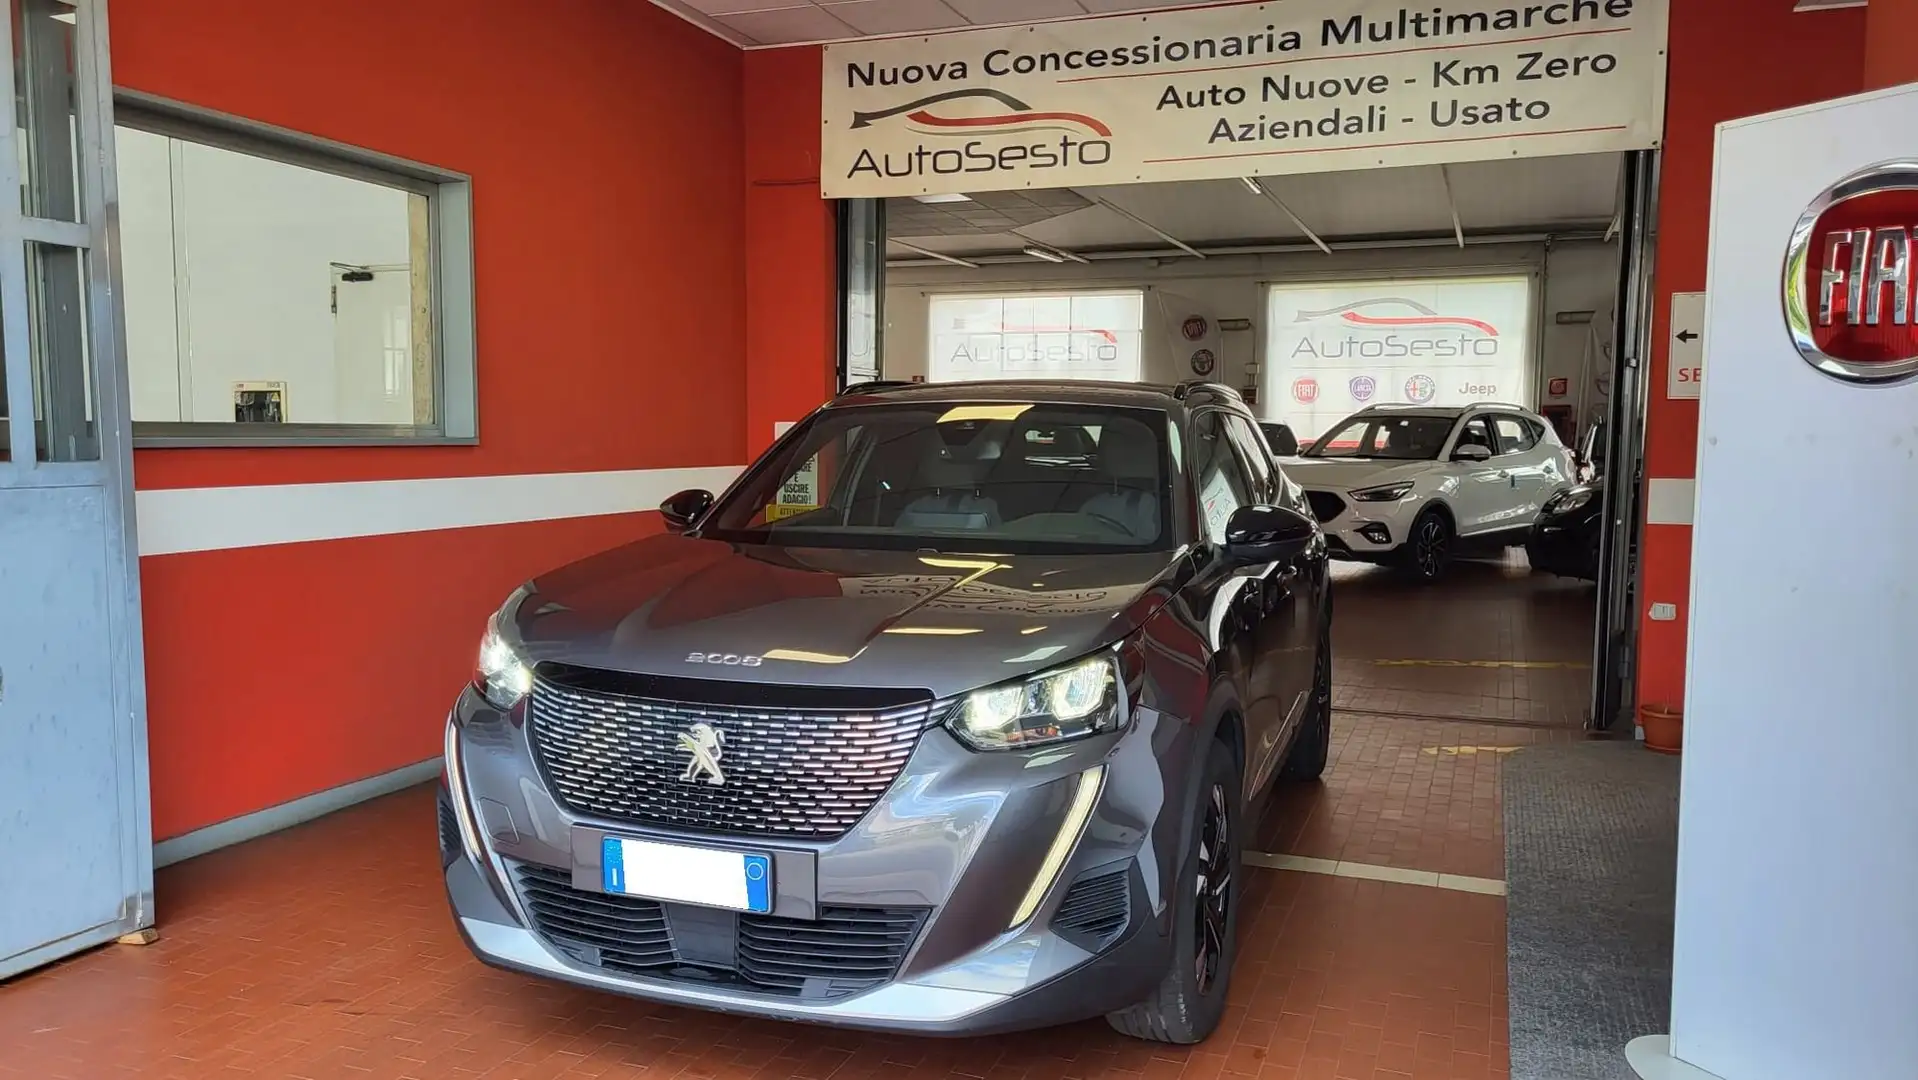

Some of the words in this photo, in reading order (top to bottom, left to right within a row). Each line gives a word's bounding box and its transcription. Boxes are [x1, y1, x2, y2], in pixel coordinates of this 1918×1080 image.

[847, 61, 968, 88] Nuova
[983, 24, 1301, 76] Concessionaria
[1321, 0, 1633, 46] Multimarche
[1156, 85, 1246, 110] Auto
[1262, 74, 1389, 102] Nuove
[1433, 59, 1499, 88] Km
[1516, 52, 1617, 81] Zero
[1208, 105, 1386, 144] Aziendali
[1431, 98, 1550, 128] Usato
[847, 135, 1111, 179] AutoSesto
[1819, 226, 1918, 325] FIA
[1291, 333, 1498, 358] AutoSesto
[1297, 384, 1315, 397] FIAT
[1458, 382, 1497, 397] Jeep
